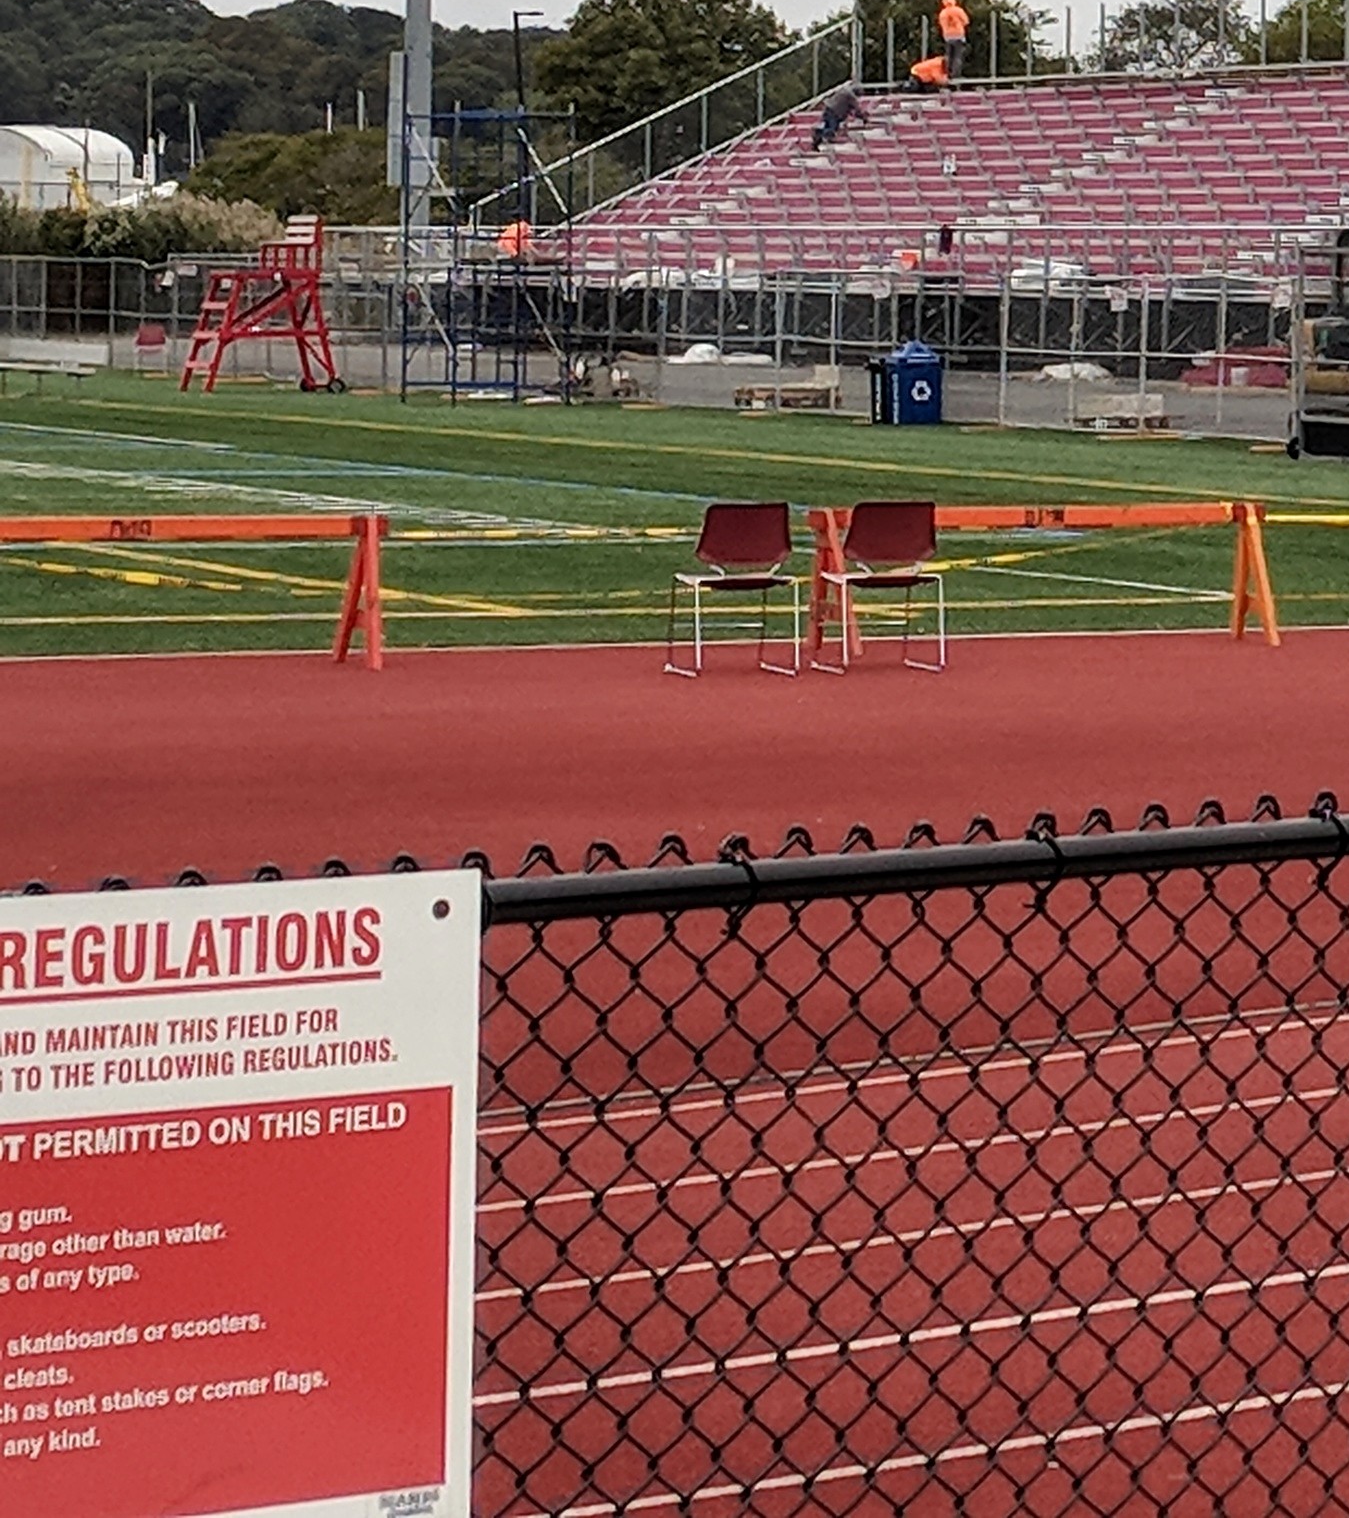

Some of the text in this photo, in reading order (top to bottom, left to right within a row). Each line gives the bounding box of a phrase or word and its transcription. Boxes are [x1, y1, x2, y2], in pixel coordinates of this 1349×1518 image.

[0, 907, 382, 991] REGULATIONS
[46, 1022, 159, 1054] MAINTAIN
[167, 1018, 218, 1044] THIS
[226, 1013, 287, 1040] FIELD
[295, 1008, 338, 1035] FOR
[11, 1065, 42, 1093] TO
[50, 1061, 95, 1090] THE
[104, 1048, 235, 1084] FOLLOWING
[243, 1038, 399, 1074] REGULATIONS.
[33, 1121, 201, 1160] PERMITTED
[208, 1114, 251, 1145] ON
[258, 1109, 320, 1141] THIS
[328, 1101, 408, 1135] FIELD
[19, 1206, 73, 1232] gum.
[52, 1232, 111, 1256] other
[113, 1227, 160, 1250] than
[164, 1221, 228, 1245] water.
[16, 1267, 41, 1292] of
[43, 1269, 84, 1292] any
[87, 1263, 140, 1288] type.
[7, 1313, 268, 1357] skateboards or scooters.
[4, 1364, 75, 1390] cleats.
[23, 1402, 50, 1422] as
[54, 1393, 98, 1419] tent
[101, 1387, 171, 1414] stakes
[174, 1384, 199, 1405] or
[202, 1376, 271, 1402] corner
[273, 1369, 331, 1395] flags.
[4, 1426, 102, 1461] any kind.
